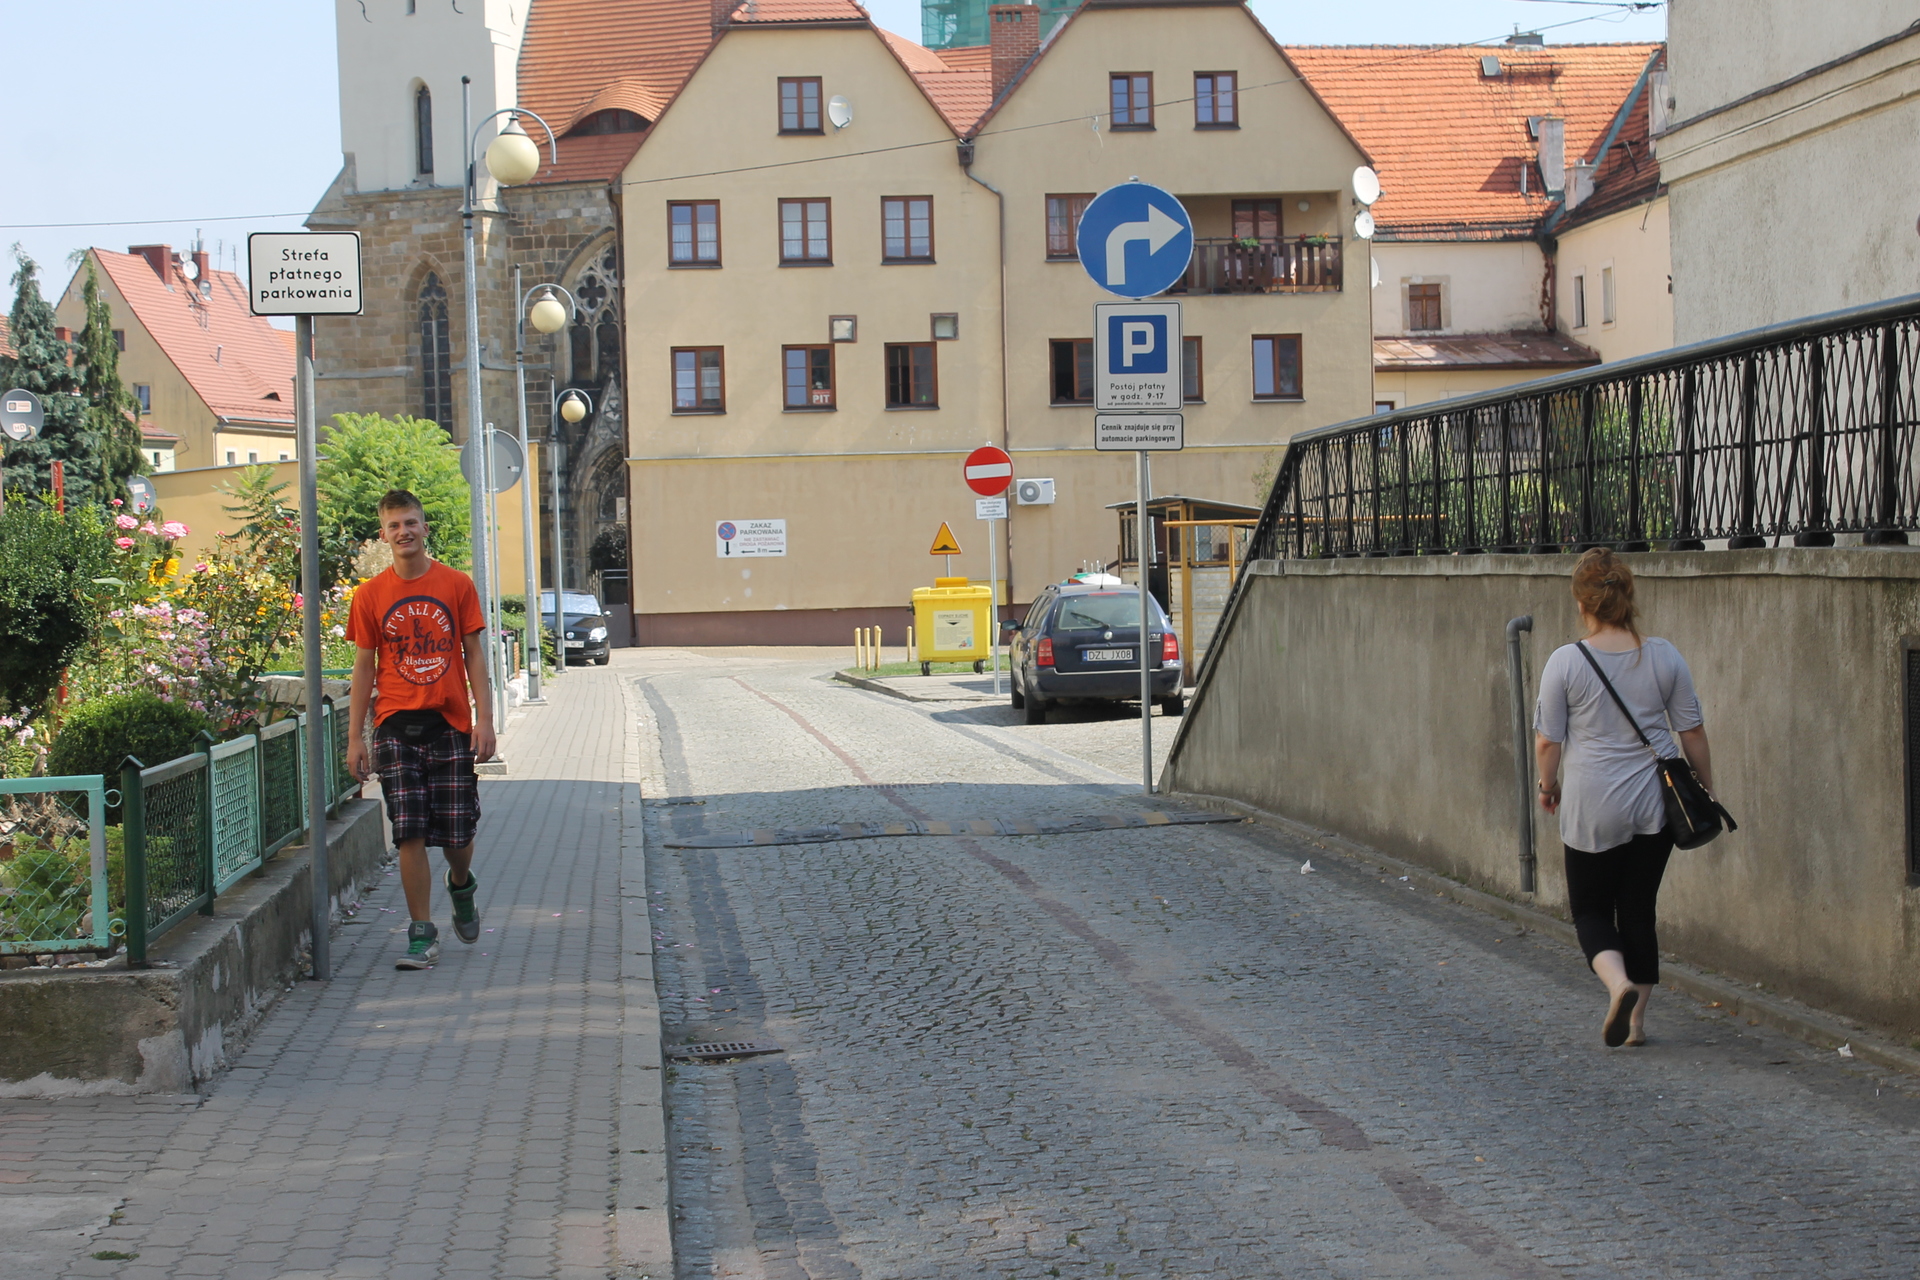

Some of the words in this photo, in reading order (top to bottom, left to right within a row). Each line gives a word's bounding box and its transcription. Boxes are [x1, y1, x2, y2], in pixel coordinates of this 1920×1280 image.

[281, 249, 329, 261] Strefa
[269, 267, 342, 284] płatnego
[260, 286, 352, 303] parkowania
[1122, 321, 1155, 367] P
[1110, 382, 1136, 391] Postój
[1138, 382, 1166, 391] płatny
[812, 394, 830, 404] PIT
[1120, 392, 1143, 401] godz.
[1147, 392, 1164, 400] 9-17
[1101, 423, 1122, 431] Cennik
[1124, 423, 1150, 432] znajduje
[1151, 423, 1161, 432] się
[1162, 424, 1176, 432] przy
[1135, 434, 1176, 443] parkingowym
[386, 610, 405, 635] IT'S
[431, 608, 451, 633] FUN
[387, 631, 454, 665] Fishes
[1088, 650, 1107, 660] DZL
[1111, 650, 1132, 659] JX08
[404, 656, 445, 668] Upstream
